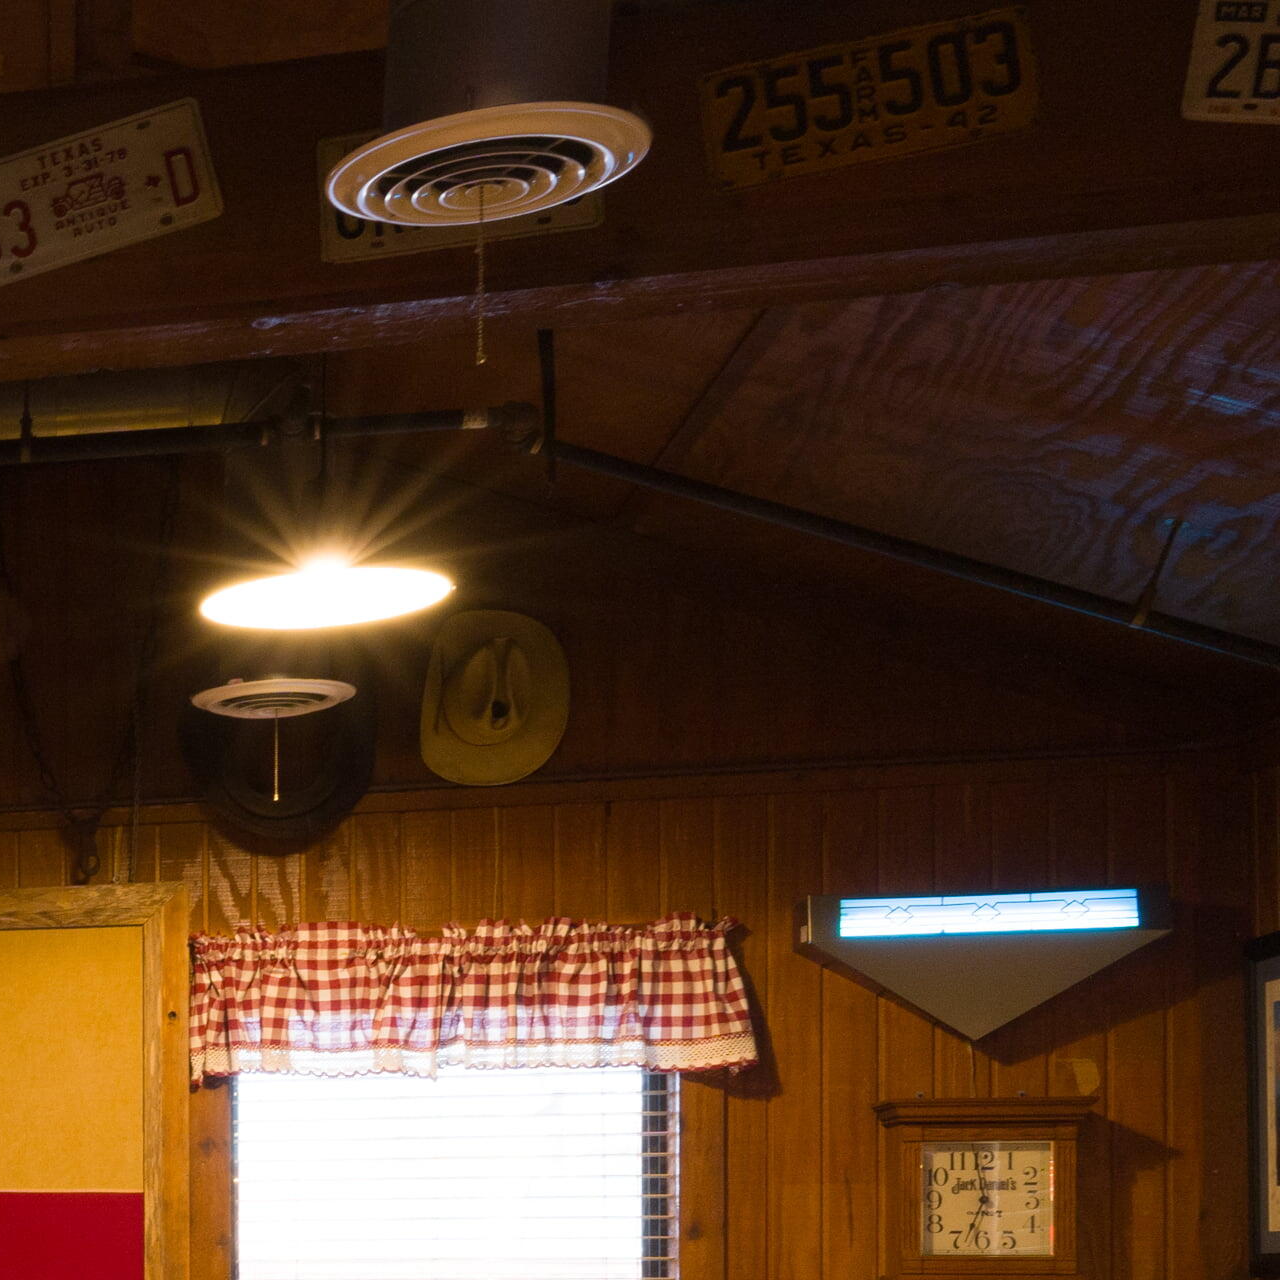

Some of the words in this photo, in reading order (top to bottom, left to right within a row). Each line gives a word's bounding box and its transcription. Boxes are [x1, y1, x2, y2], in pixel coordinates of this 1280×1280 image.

[716, 55, 853, 152] 255
[878, 22, 1021, 115] 503
[38, 137, 103, 170] TEXAS
[927, 1166, 949, 1187] 10
[1023, 1166, 1038, 1186] 2
[926, 1189, 943, 1210] 9
[927, 1214, 944, 1233] 8
[948, 1230, 963, 1250] 7
[974, 1230, 991, 1250] 6
[1000, 1230, 1017, 1250] 5
